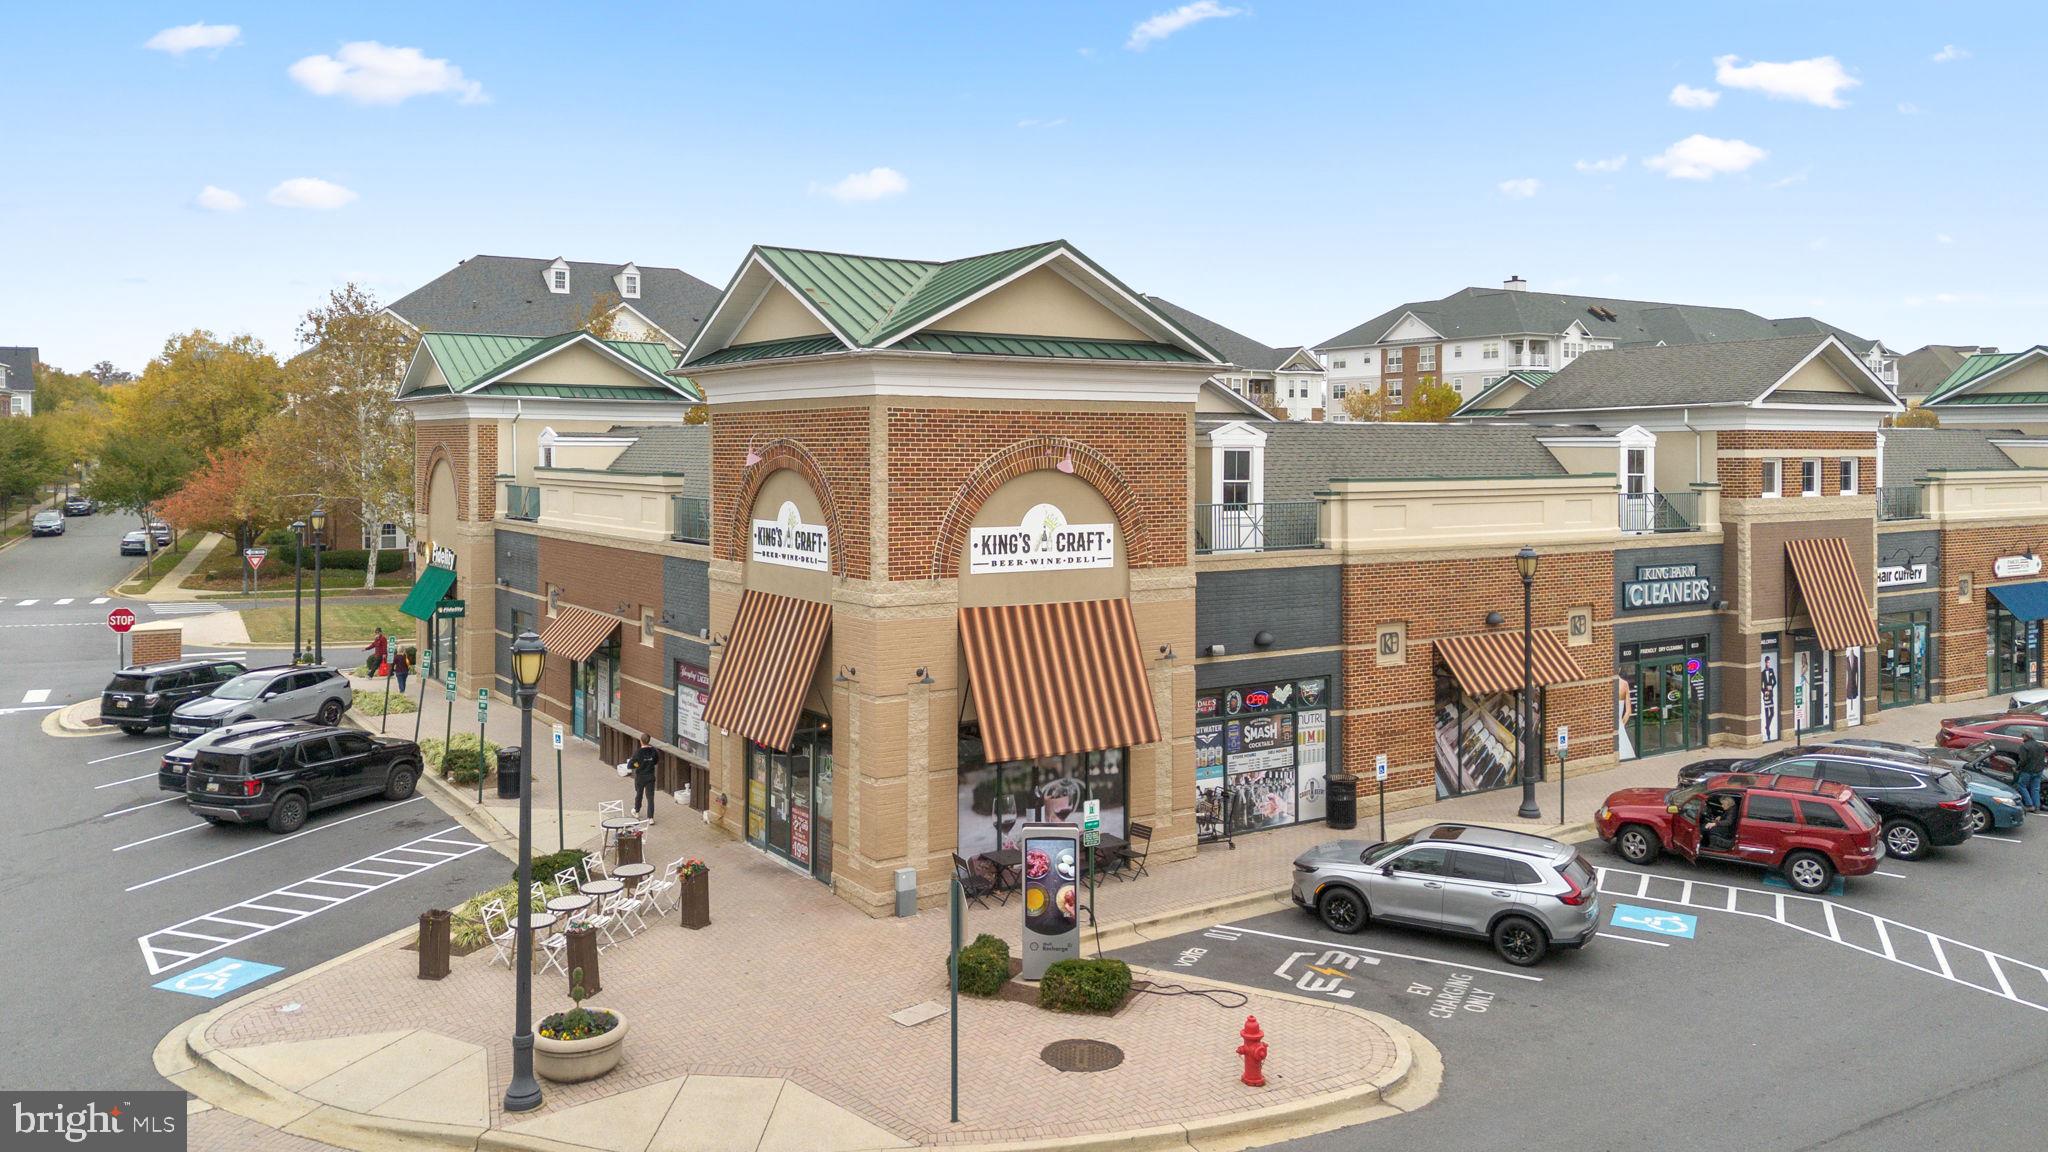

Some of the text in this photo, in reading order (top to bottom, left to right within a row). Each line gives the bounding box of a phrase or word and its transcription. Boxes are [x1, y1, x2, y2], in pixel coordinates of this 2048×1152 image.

[757, 526, 823, 552] KING'S CRAFT
[981, 531, 1105, 555] KING'S CRAFT
[991, 555, 1096, 567] BEER WINE DELI
[1645, 565, 1697, 579] KING FARM
[1628, 580, 1710, 606] CLEANERS
[109, 615, 135, 626] STOP
[1246, 694, 1269, 705] OPEN
[1243, 721, 1278, 743] SMASH
[1248, 740, 1274, 749] COCKTAILS
[1406, 982, 1433, 996] EV
[1428, 973, 1474, 1019] CHARGING
[1463, 987, 1496, 1013] ONLY
